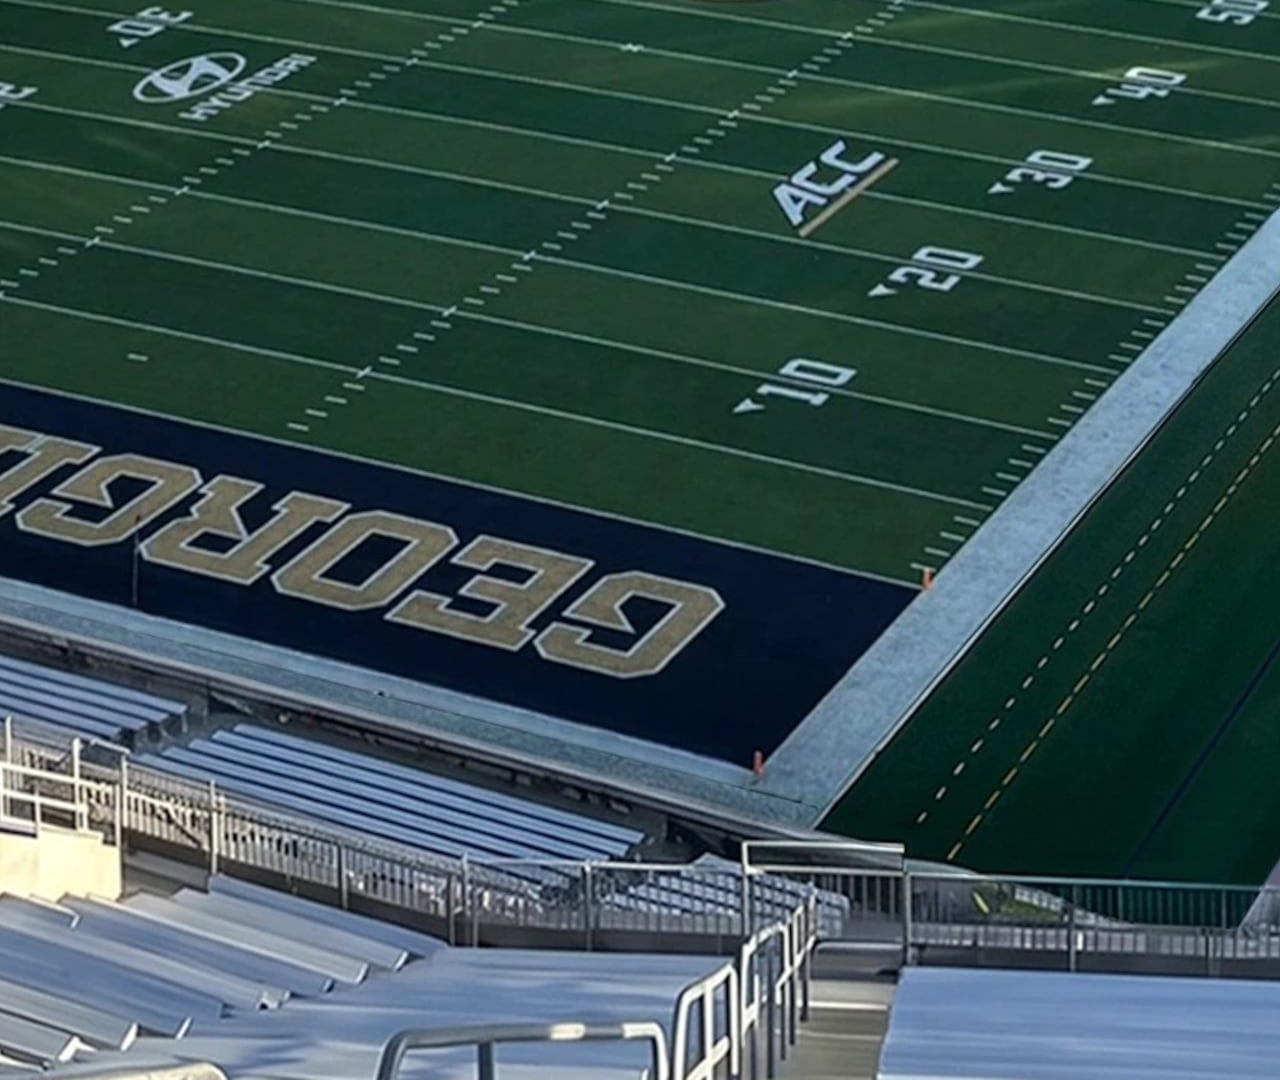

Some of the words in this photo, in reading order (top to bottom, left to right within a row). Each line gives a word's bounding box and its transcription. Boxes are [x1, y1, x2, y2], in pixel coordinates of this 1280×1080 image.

[177, 52, 318, 122] HYUNDAI
[1106, 65, 1188, 100] 40
[772, 139, 886, 227] ACC
[1006, 148, 1094, 190] 30
[889, 245, 984, 292] 20
[756, 357, 858, 407] 10
